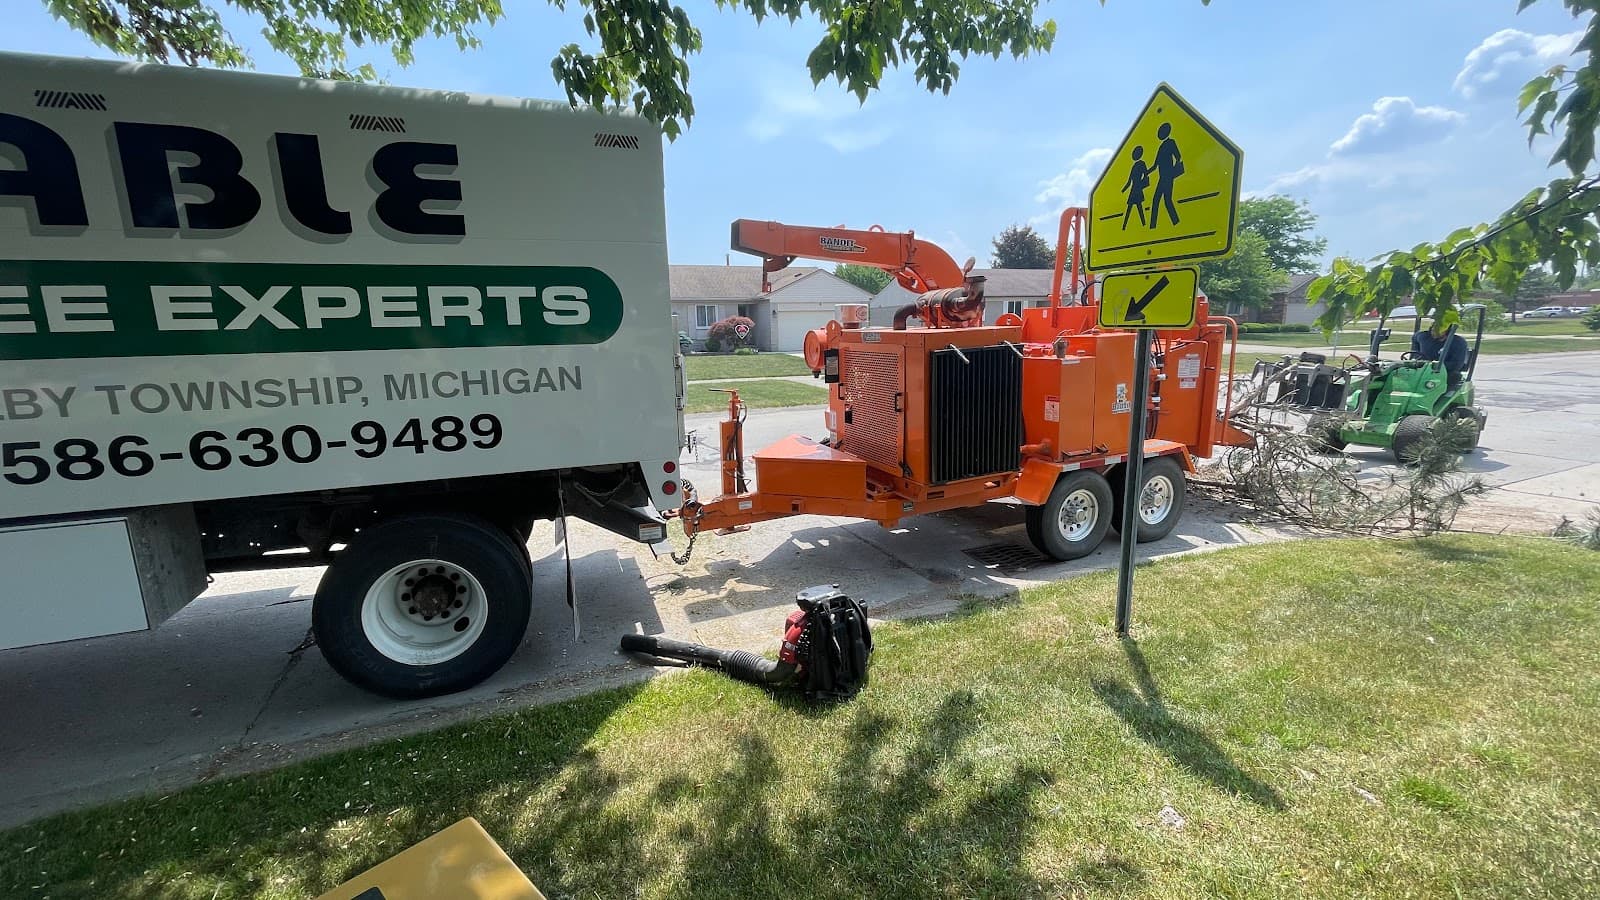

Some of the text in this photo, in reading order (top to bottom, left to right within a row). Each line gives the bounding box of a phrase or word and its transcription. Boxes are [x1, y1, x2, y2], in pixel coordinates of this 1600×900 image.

[820, 237, 855, 247] BANDIT
[150, 285, 591, 331] EXPERTS
[0, 365, 583, 421] BY TOWNSHIP, MICHIGAN
[1, 413, 503, 485] 586-630-9489
